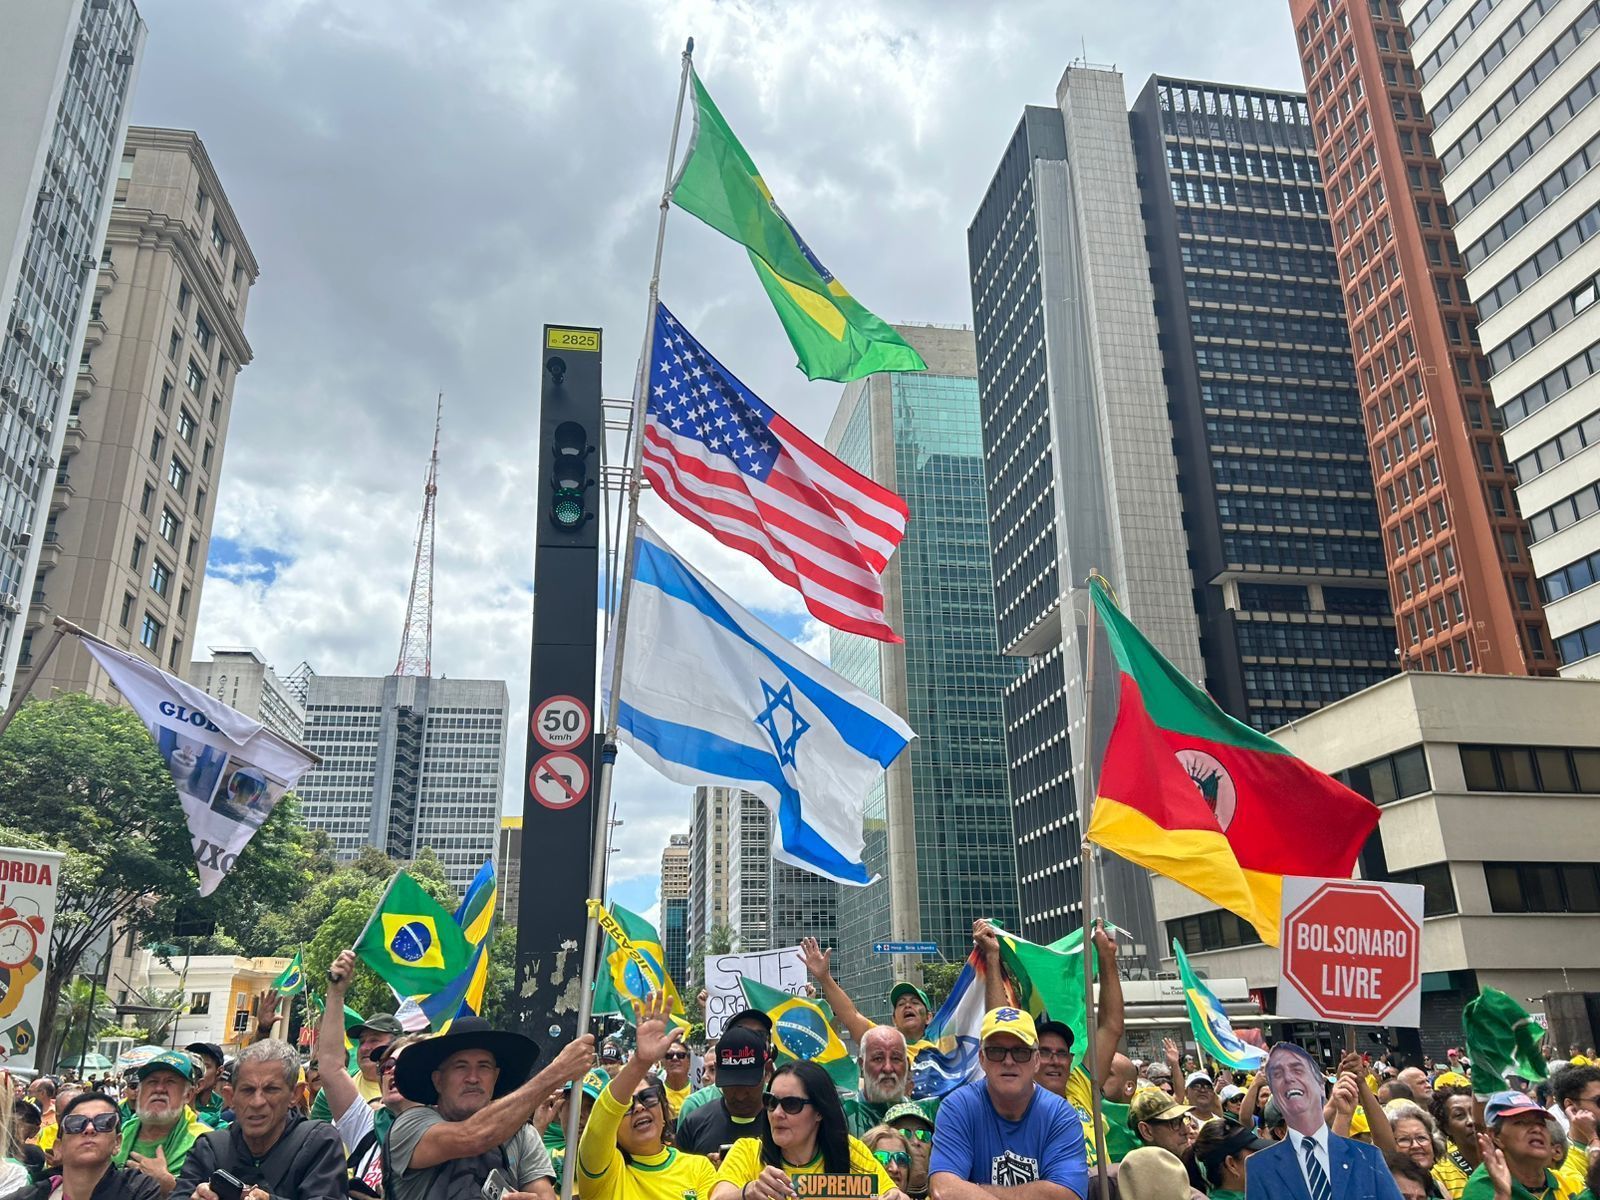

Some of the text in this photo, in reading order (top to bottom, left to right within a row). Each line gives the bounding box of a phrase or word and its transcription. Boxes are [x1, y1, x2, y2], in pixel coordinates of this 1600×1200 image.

[562, 334, 595, 346] 2825
[543, 709, 580, 732] 50
[549, 733, 572, 741] km/h
[1297, 922, 1407, 958] BOLSONARO
[714, 949, 799, 991] STF
[1321, 963, 1382, 1000] LIVRE
[721, 1056, 756, 1066] SILVER
[798, 1174, 872, 1196] SUPREMO
